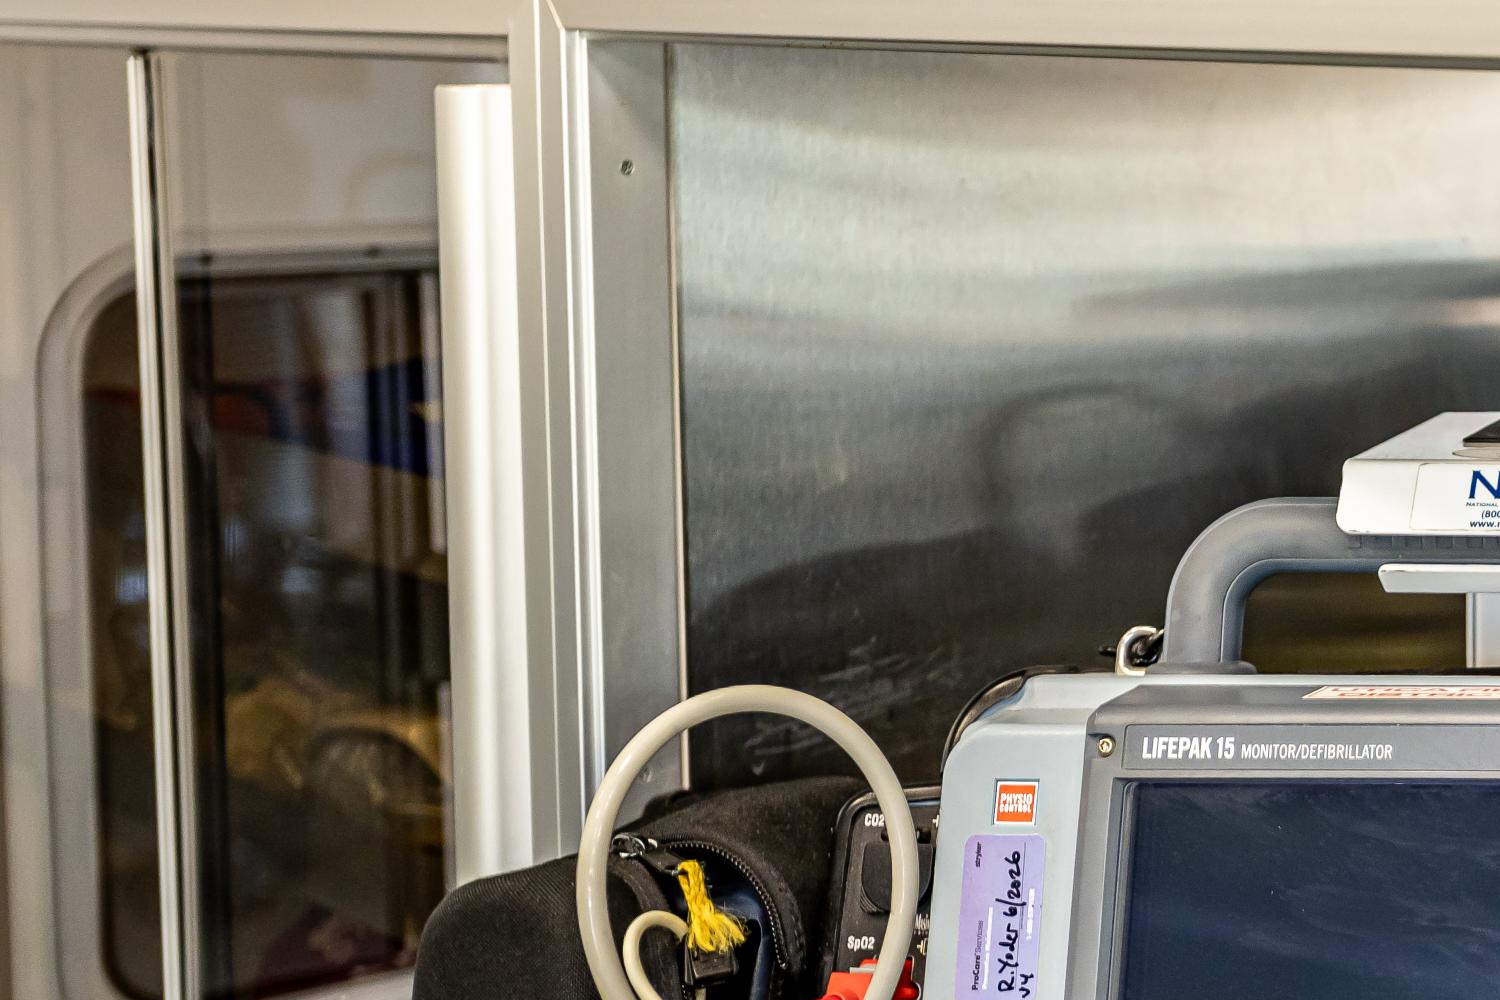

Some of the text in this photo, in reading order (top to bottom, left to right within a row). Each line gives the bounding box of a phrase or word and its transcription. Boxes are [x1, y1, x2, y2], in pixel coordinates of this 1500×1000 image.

[1141, 736, 1236, 760] LIFEPAK 15
[1240, 743, 1394, 761] MONITOR/DEFIBRILLATOR
[1000, 792, 1033, 804] PHYSIO
[999, 803, 1032, 814] CONTROL
[864, 812, 885, 827] CO2
[847, 935, 875, 952] SpO2
